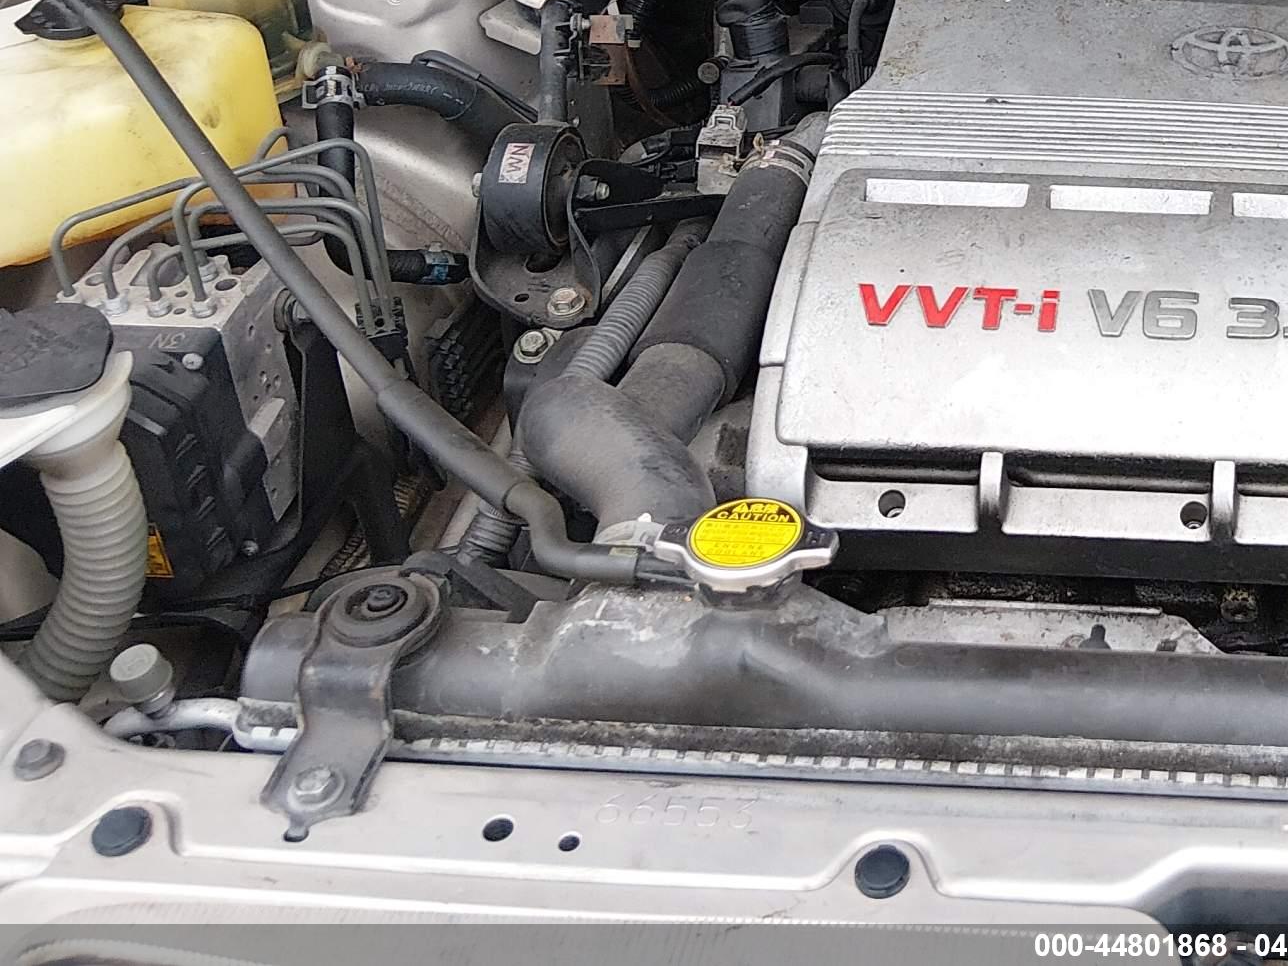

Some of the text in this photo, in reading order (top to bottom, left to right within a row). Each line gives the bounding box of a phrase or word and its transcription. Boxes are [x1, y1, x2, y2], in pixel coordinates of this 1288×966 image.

[858, 283, 1061, 332] VVT-i
[1087, 289, 1200, 340] V6
[716, 511, 790, 523] CAUTION
[594, 794, 761, 829] 66553
